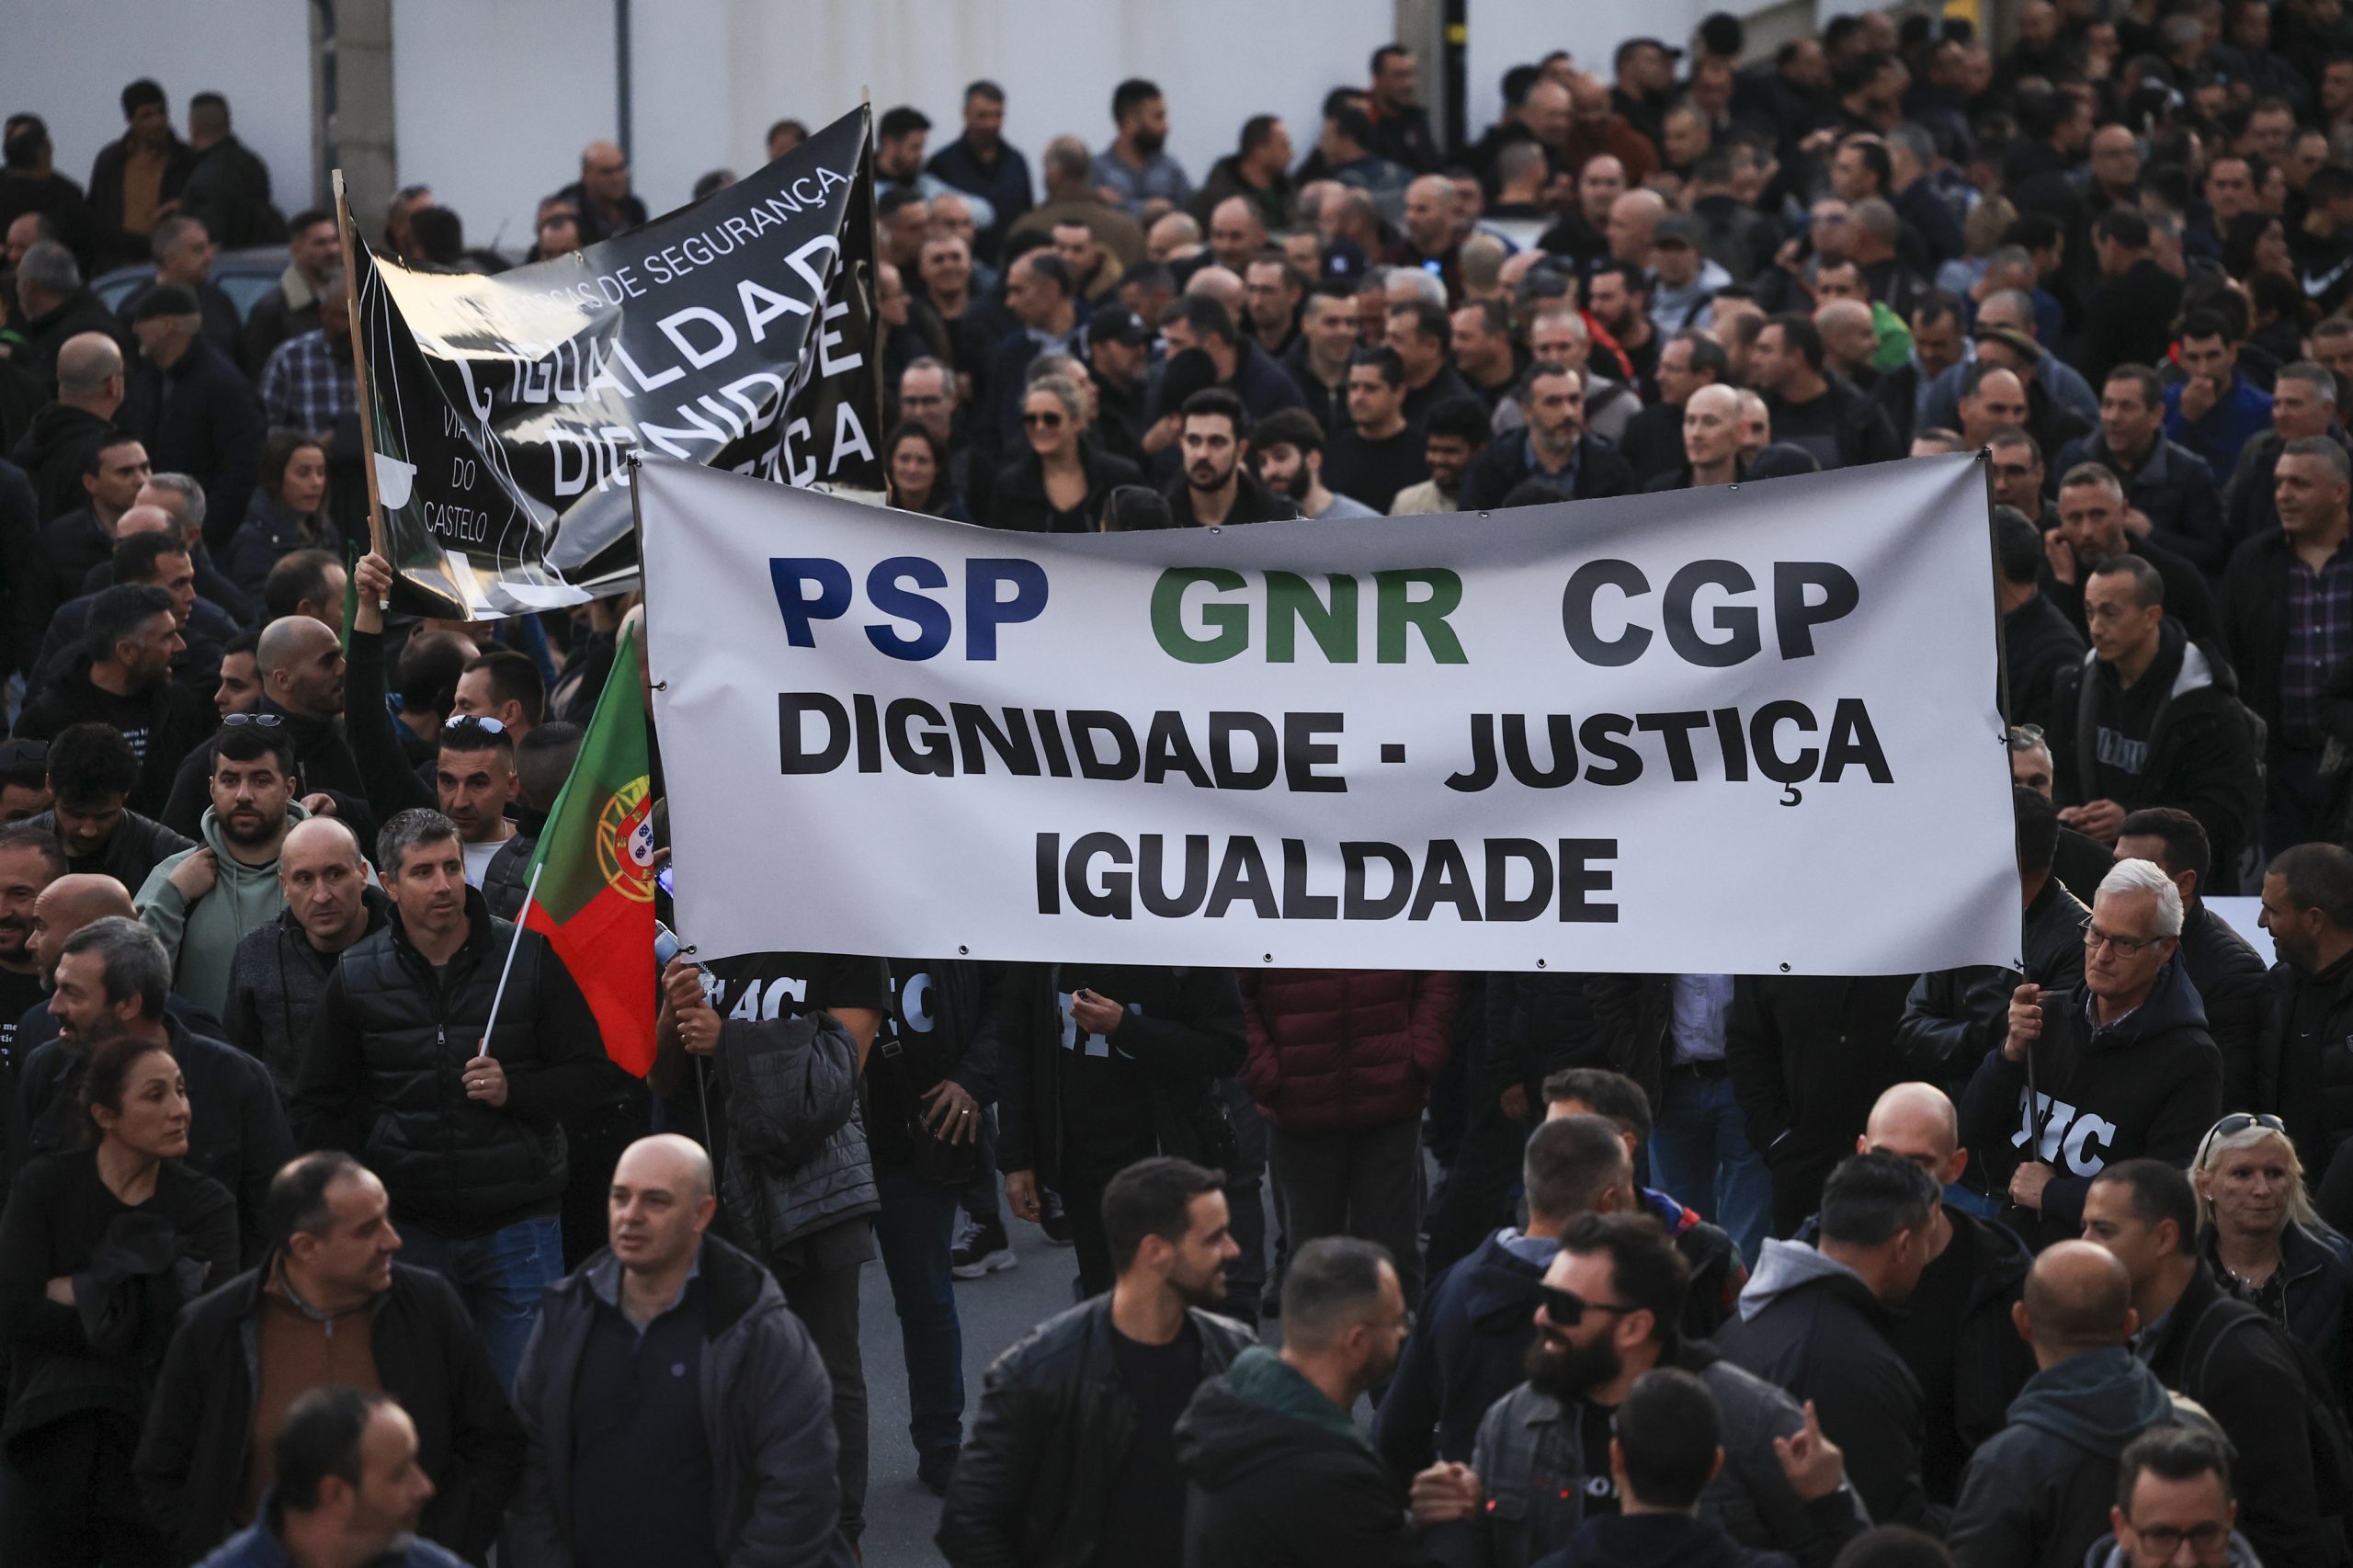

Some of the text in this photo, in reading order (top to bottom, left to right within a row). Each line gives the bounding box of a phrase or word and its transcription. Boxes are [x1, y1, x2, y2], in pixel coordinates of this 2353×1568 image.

[496, 228, 847, 403] IGUALDAD
[597, 267, 647, 306] DE
[444, 405, 472, 441] VIA
[452, 457, 476, 491] DO
[425, 501, 487, 543] CASTELO
[769, 556, 1859, 667] PSP GNR CGP
[779, 692, 1347, 793] DIGNIDADE
[1444, 699, 1893, 806] JUSTIÇA
[1036, 832, 1618, 923] IGUALDADE
